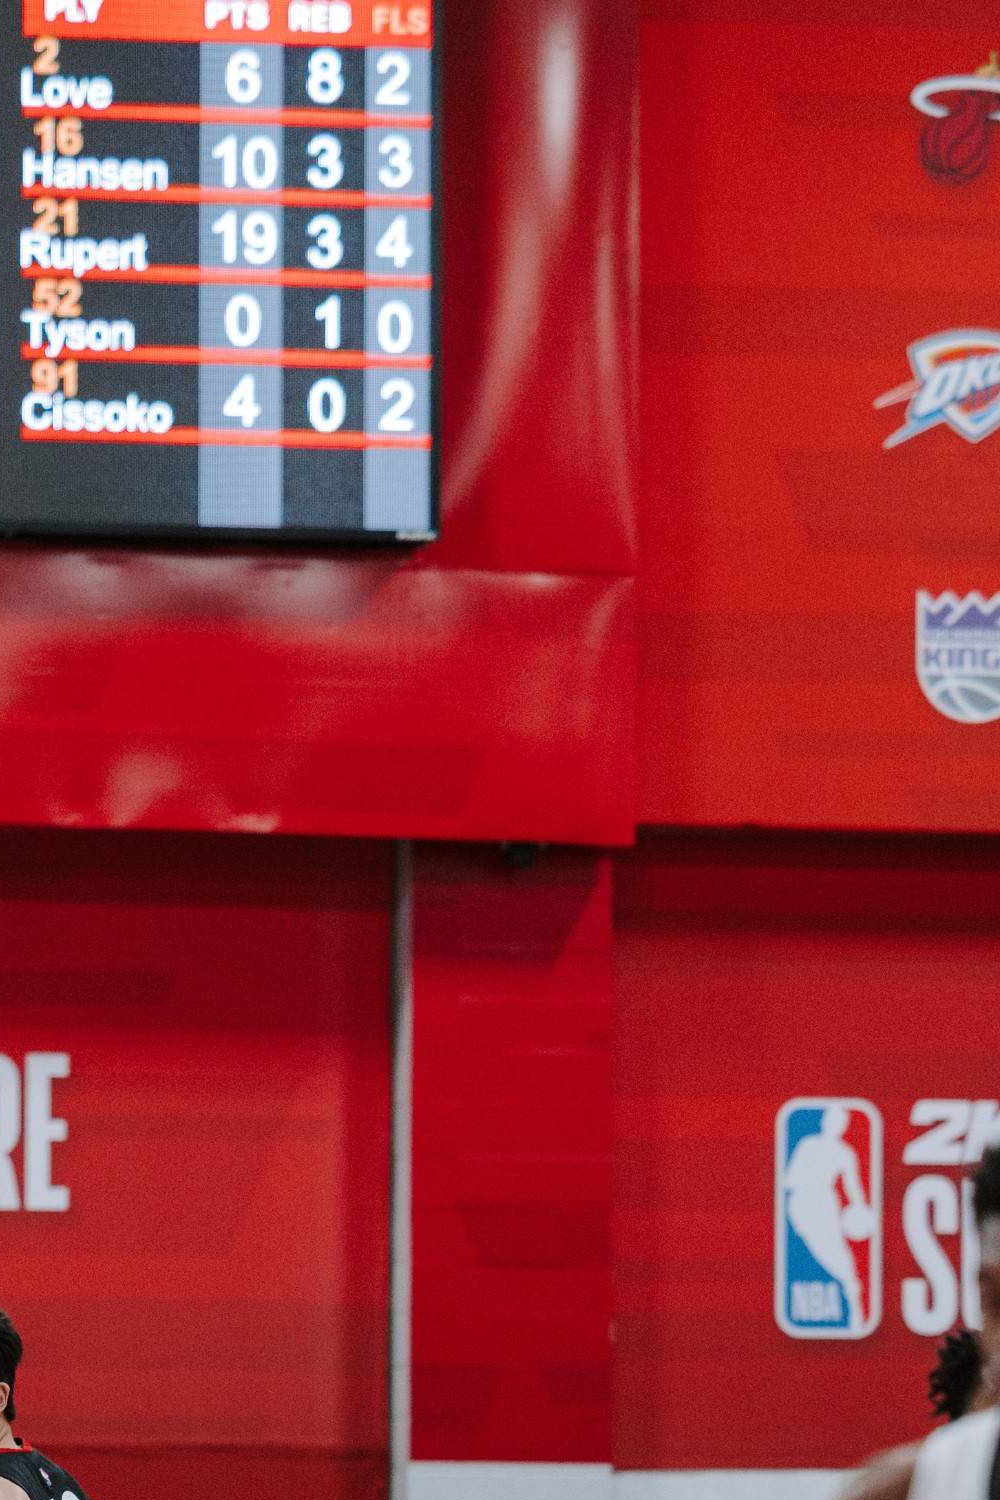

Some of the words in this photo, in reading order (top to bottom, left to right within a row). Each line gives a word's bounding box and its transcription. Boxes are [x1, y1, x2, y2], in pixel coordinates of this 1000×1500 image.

[204, 0, 270, 31] PTS
[288, 3, 352, 33] REB
[371, 8, 428, 35] FLS
[20, 69, 113, 110] Love
[226, 51, 261, 103] 6
[307, 48, 343, 104] 8
[375, 52, 411, 105] 2
[33, 37, 60, 74] 2
[33, 118, 83, 156] 16
[21, 149, 169, 191] Hansen
[211, 134, 277, 189] 10
[307, 134, 343, 189] 3
[378, 135, 413, 188] 3
[32, 198, 78, 236] 21
[20, 232, 148, 277] Rupert
[211, 211, 278, 265] 19
[307, 214, 343, 269] 3
[376, 215, 412, 268] 4
[21, 310, 135, 357] Tyson
[225, 294, 260, 347] 0
[314, 295, 341, 349] 1
[377, 299, 413, 354] 0
[31, 360, 78, 398] 91
[21, 393, 173, 433] Cissoko
[223, 374, 260, 427] 4
[308, 377, 345, 432] 0
[380, 379, 414, 433] 2
